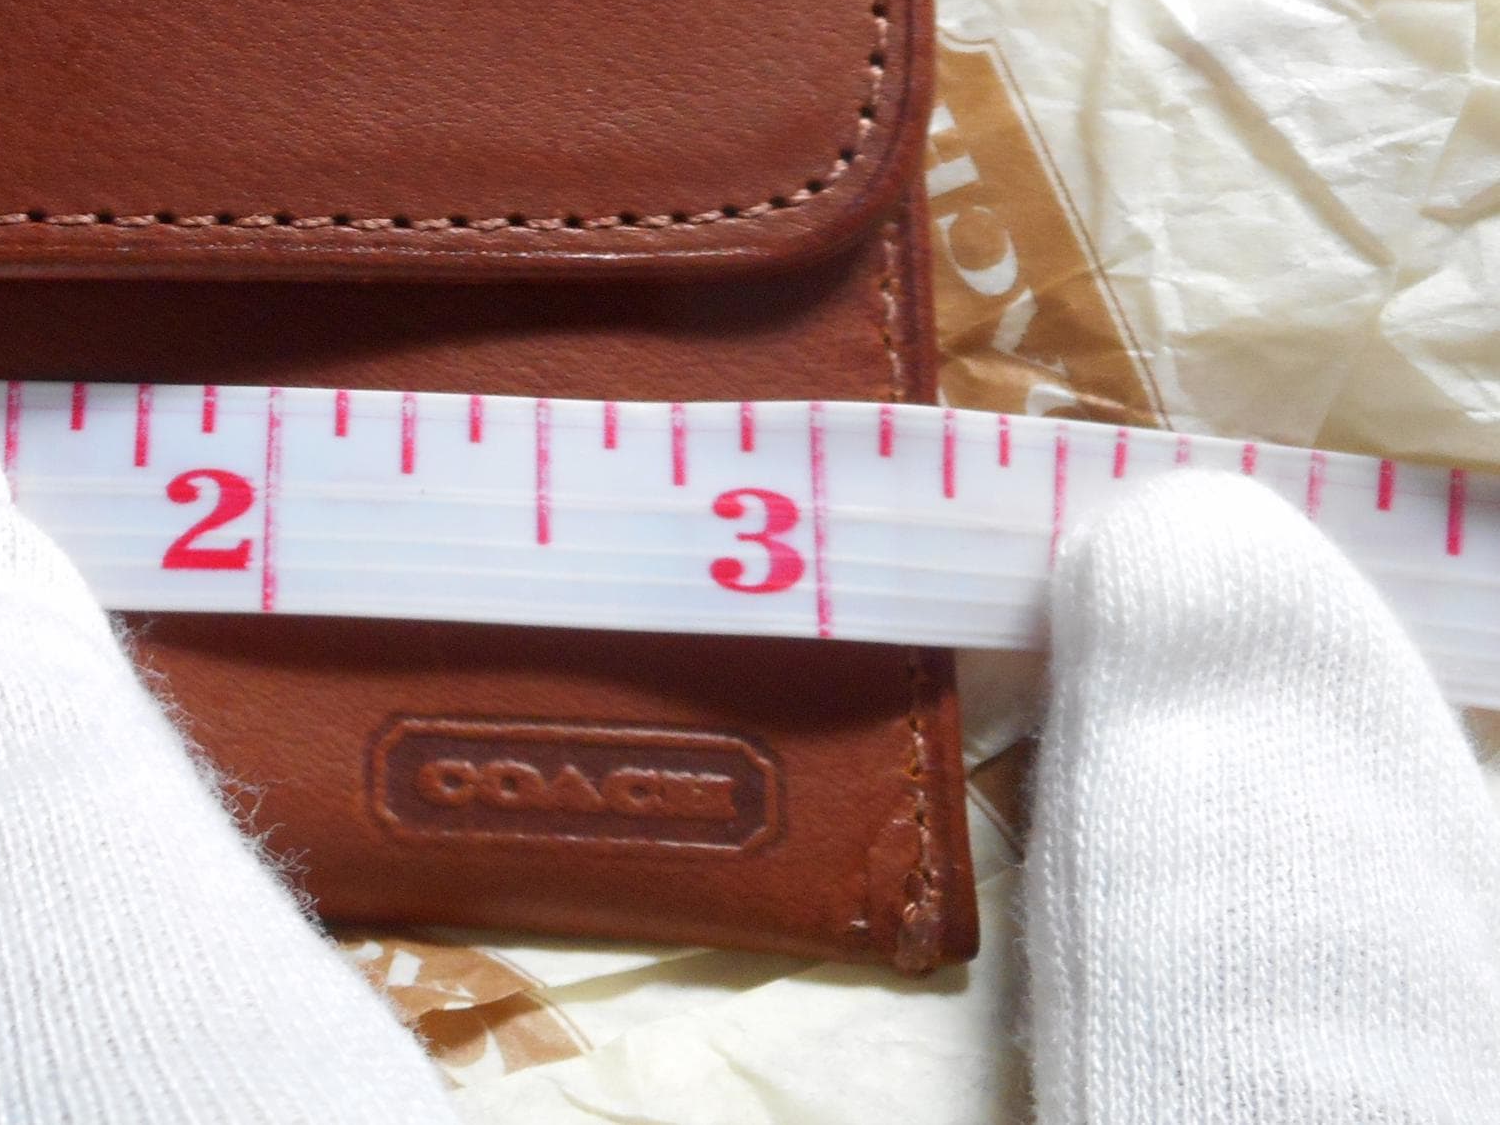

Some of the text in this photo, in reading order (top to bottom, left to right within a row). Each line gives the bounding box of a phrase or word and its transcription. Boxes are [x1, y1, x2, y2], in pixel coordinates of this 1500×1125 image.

[162, 468, 255, 571] 2
[709, 487, 806, 594] 3
[418, 758, 738, 819] COACH
